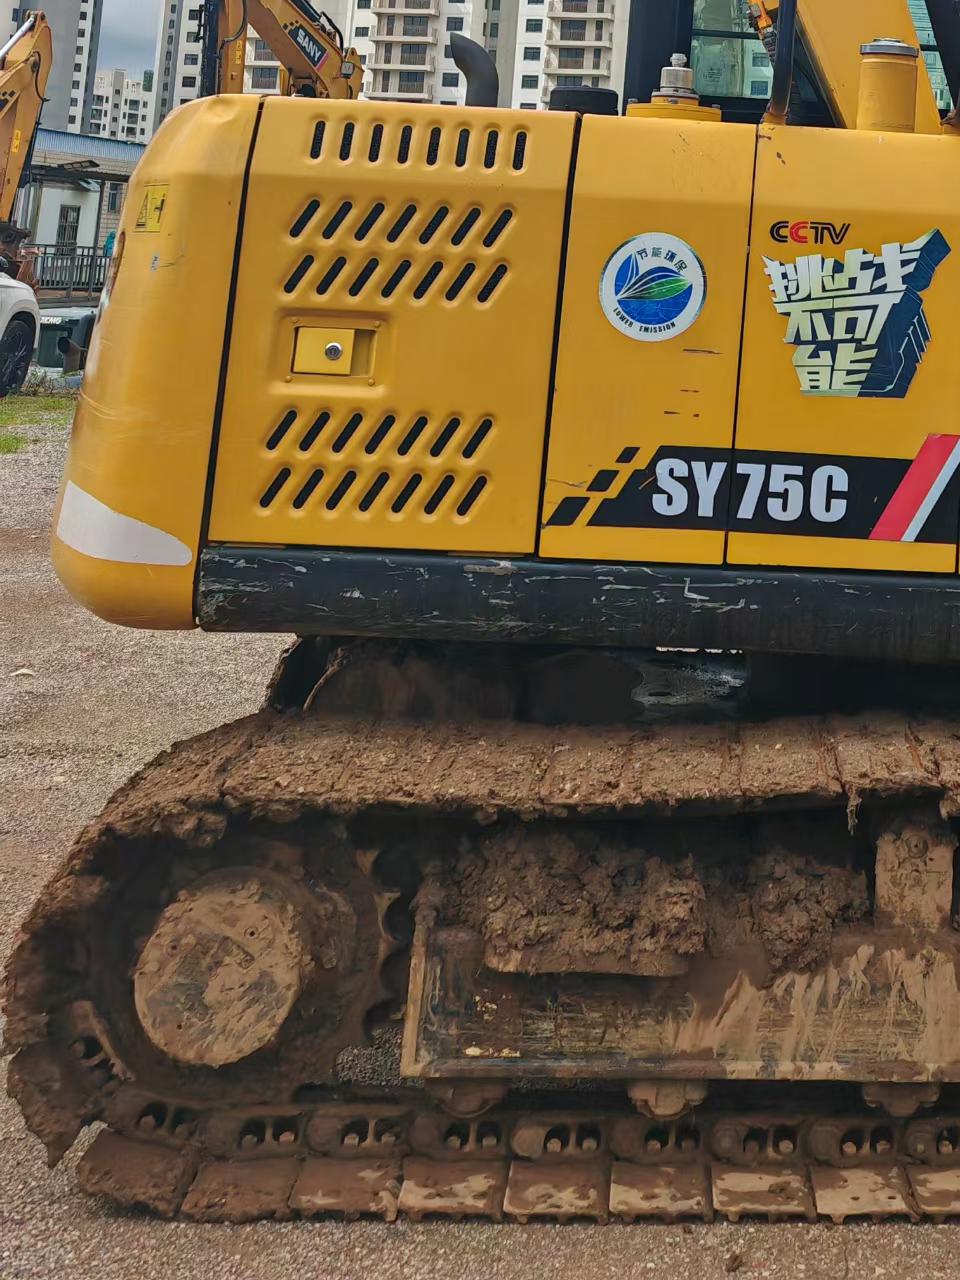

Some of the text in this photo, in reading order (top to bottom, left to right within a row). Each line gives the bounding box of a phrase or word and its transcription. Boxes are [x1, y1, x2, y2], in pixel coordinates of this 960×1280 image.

[296, 28, 321, 62] SANY
[769, 220, 850, 245] CCTV
[613, 307, 676, 334] LOWER EMISSION
